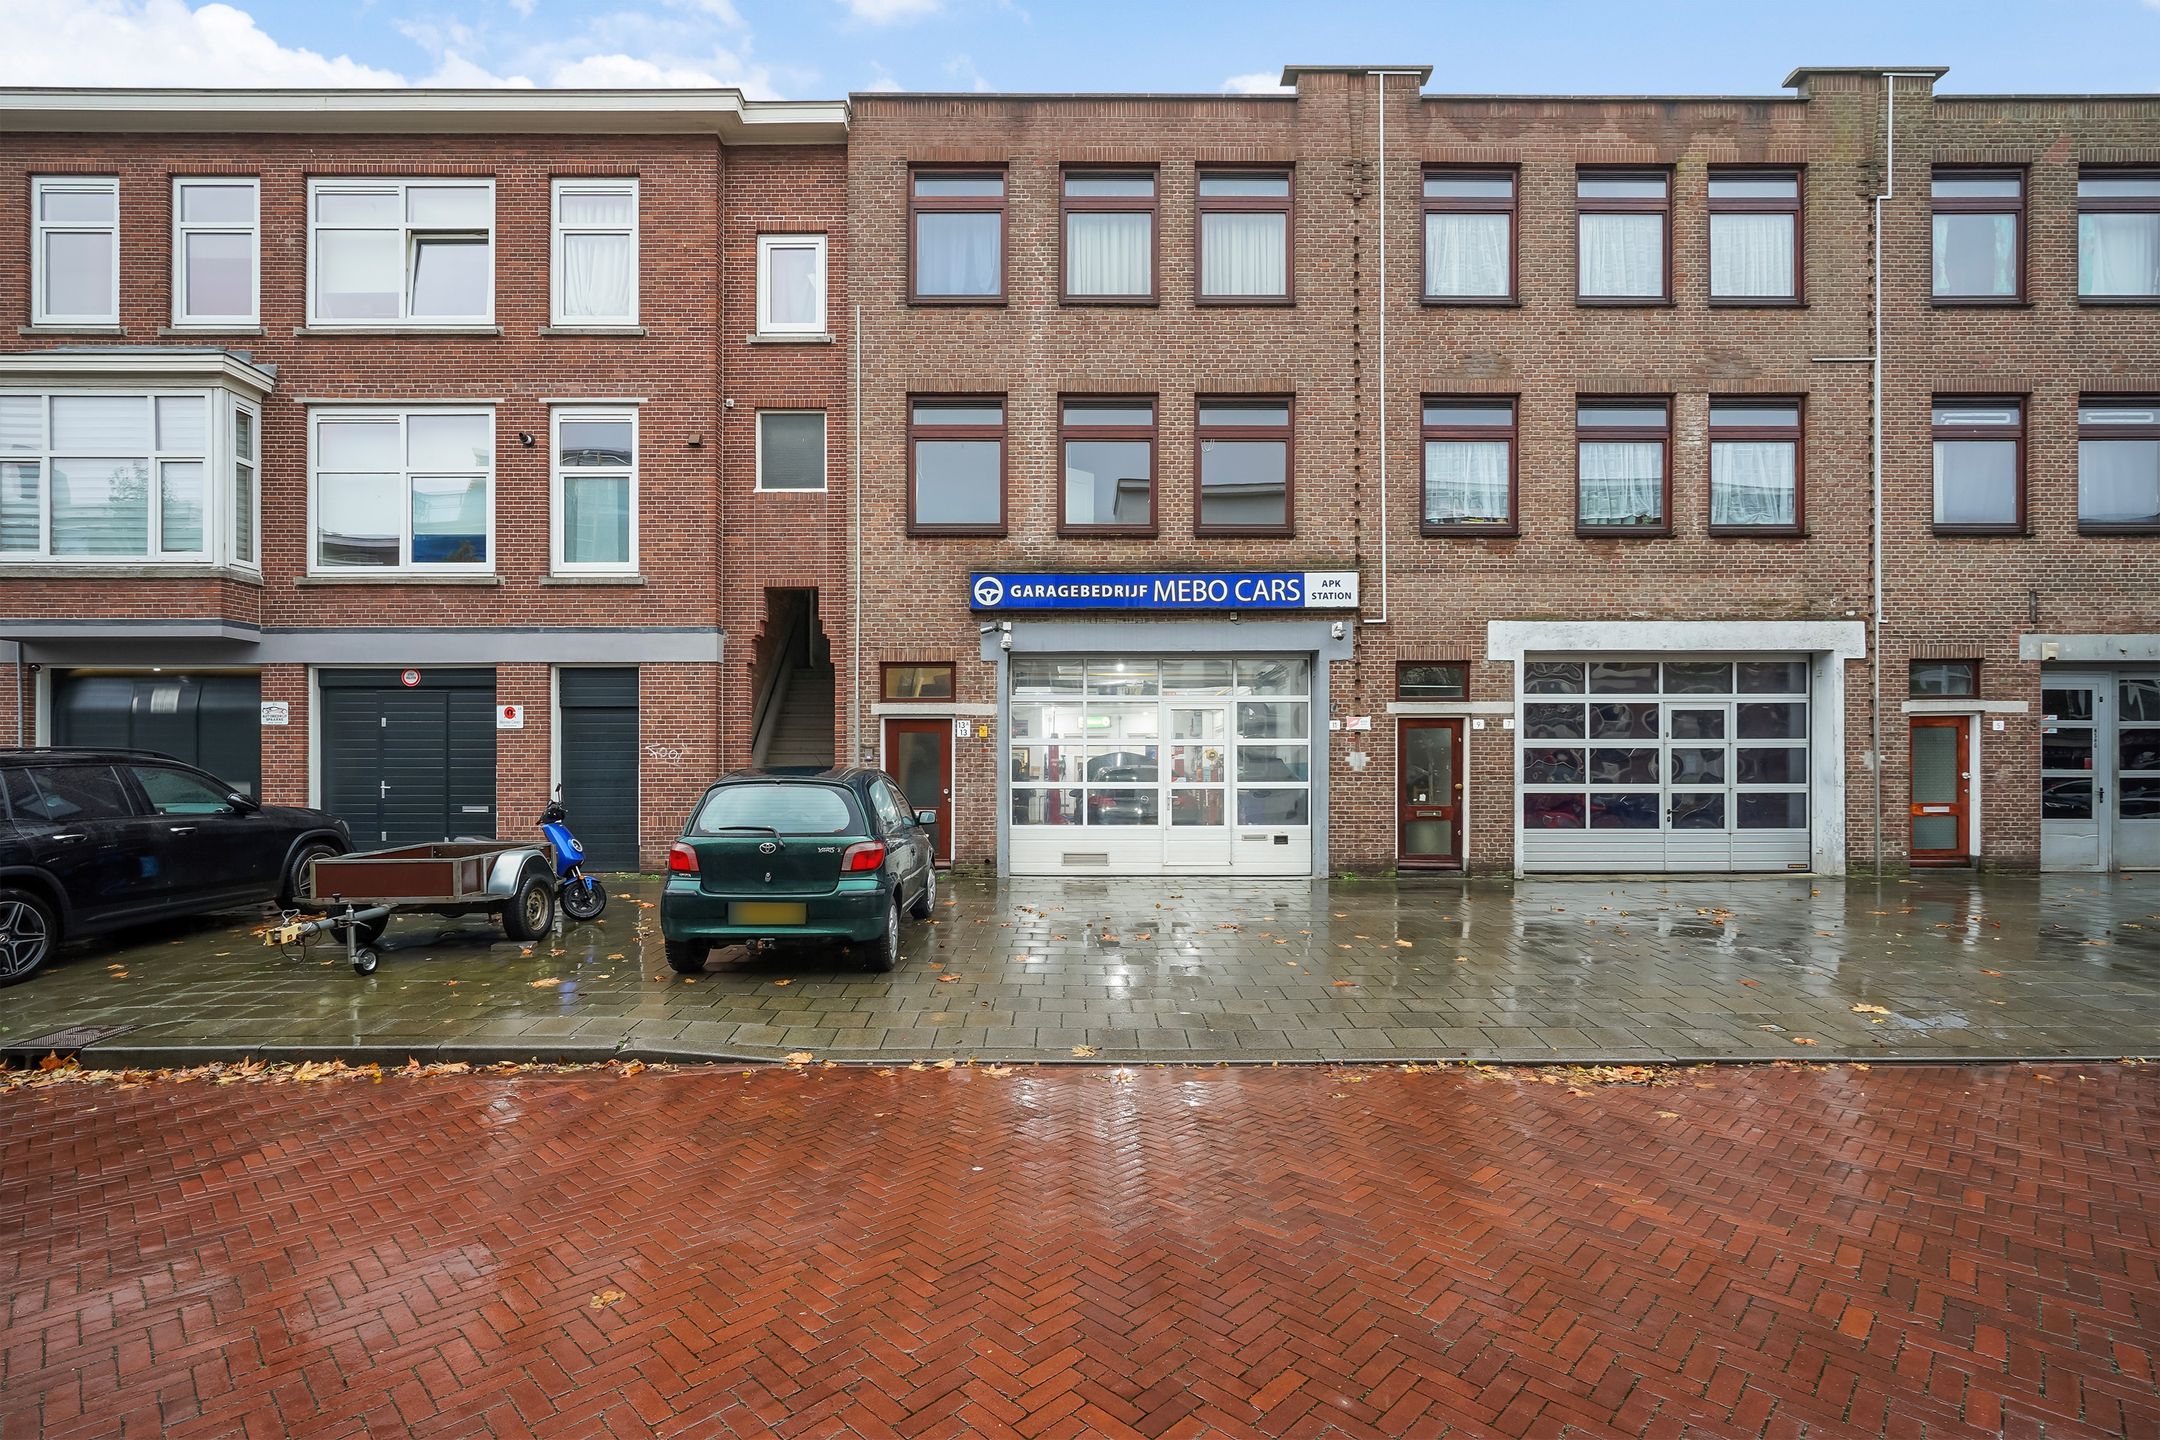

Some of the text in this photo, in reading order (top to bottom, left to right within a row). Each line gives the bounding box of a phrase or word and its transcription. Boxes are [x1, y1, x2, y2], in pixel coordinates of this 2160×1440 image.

[1321, 579, 1342, 588] APK
[1010, 578, 1301, 602] GARAGEBEDRIJF MEBO CARS
[1311, 591, 1352, 600] STATION
